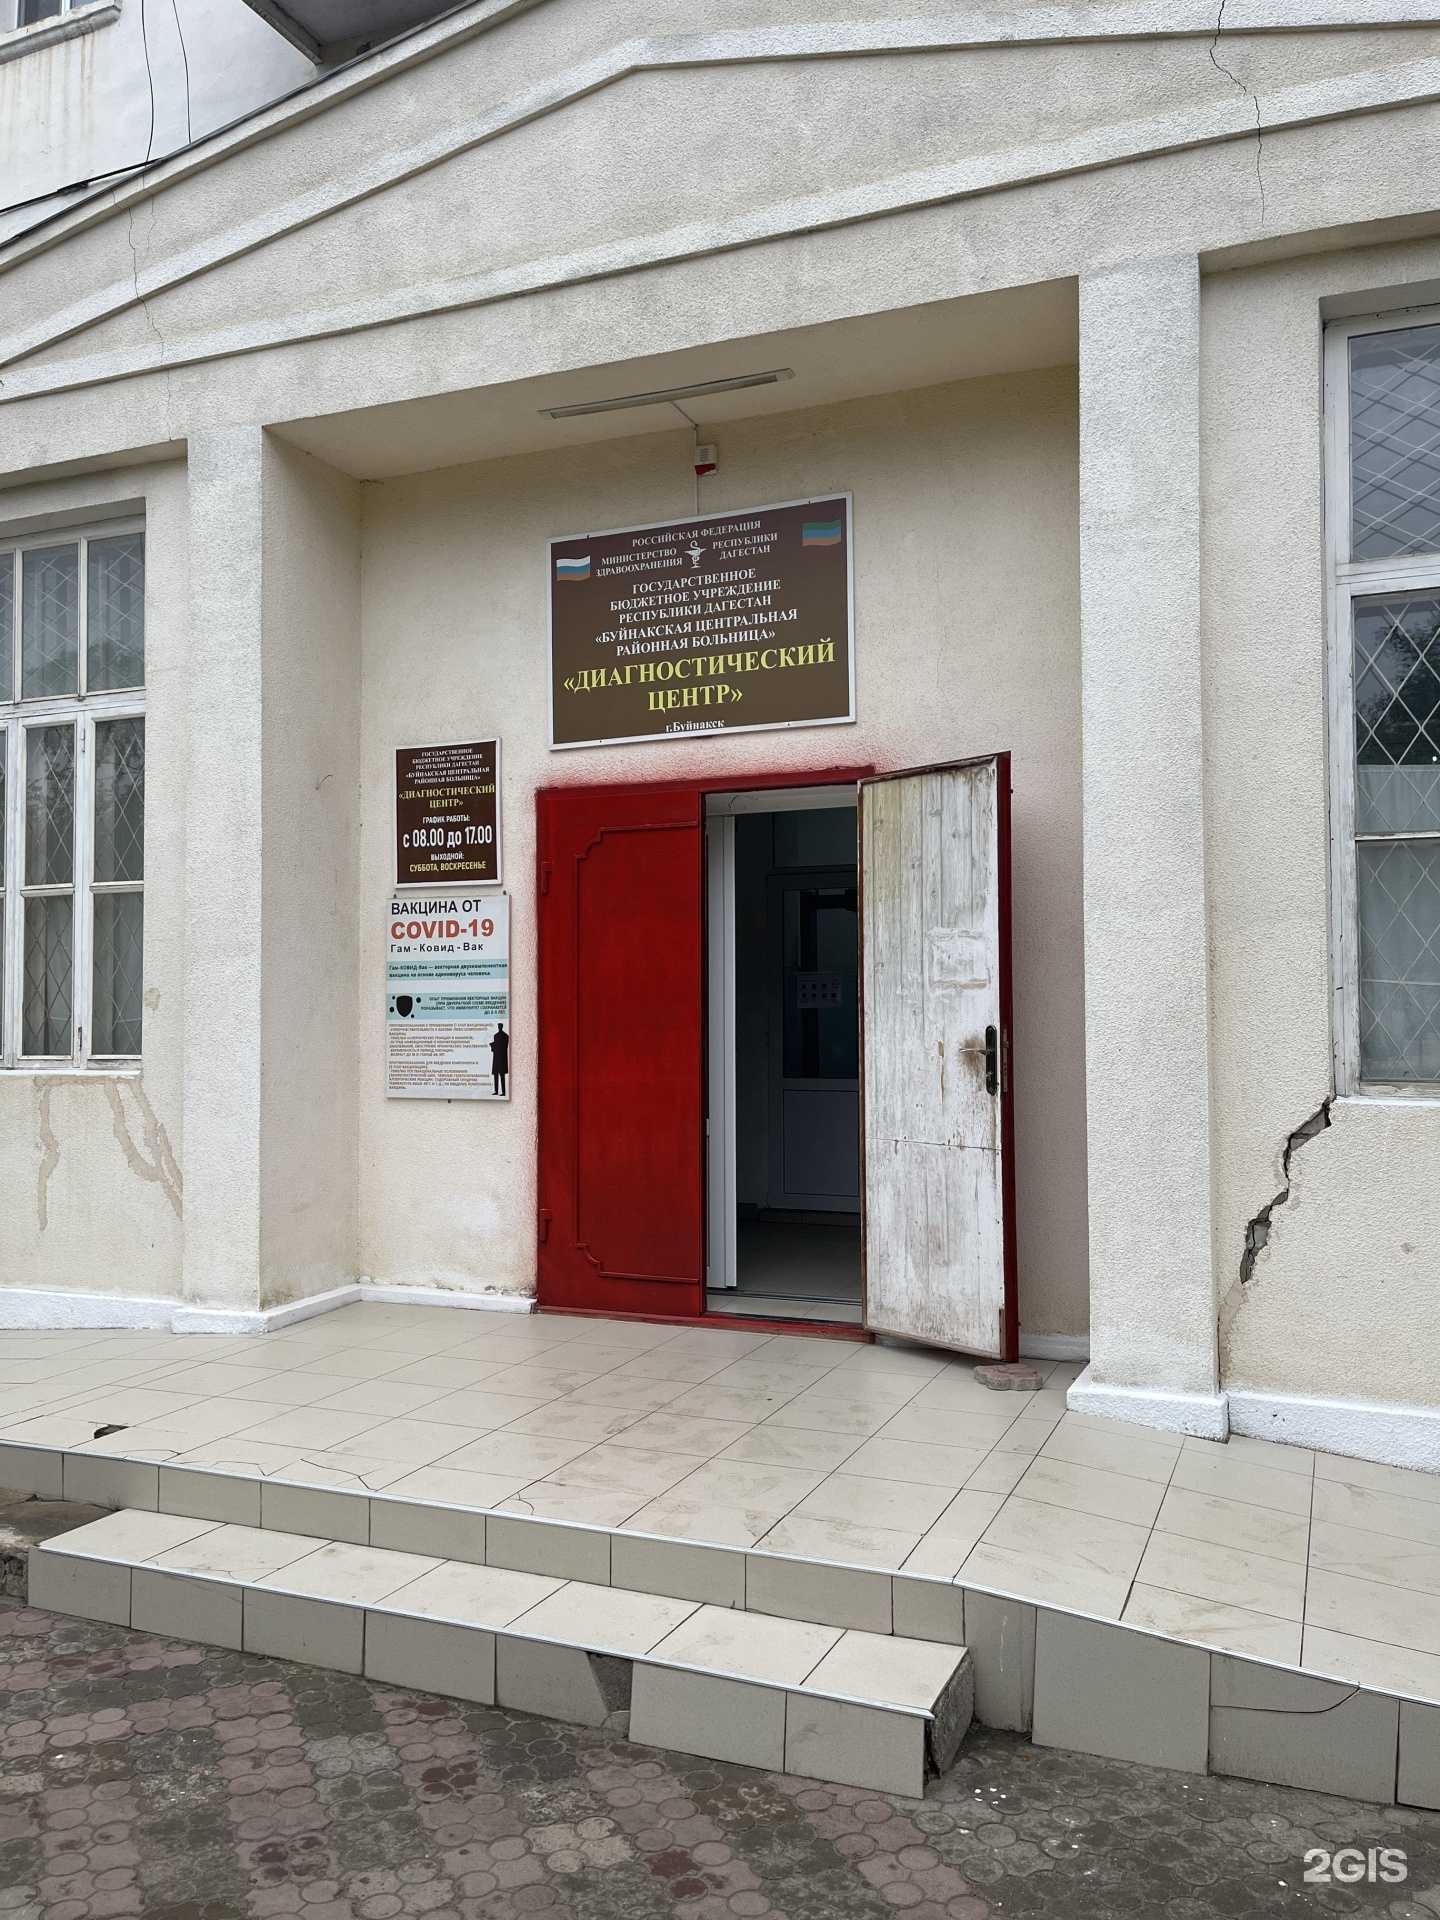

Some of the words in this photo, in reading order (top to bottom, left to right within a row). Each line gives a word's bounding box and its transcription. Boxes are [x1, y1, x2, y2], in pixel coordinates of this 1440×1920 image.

[632, 530, 699, 547] РОССИЙСКАЯ
[701, 520, 761, 537] ФЕДЕРАЦИЯ
[712, 532, 778, 550] РЕСПУБЛИКИ
[601, 548, 677, 566] МИНИСТЕРСТВО
[719, 544, 771, 560] ДАГЕСТАН
[595, 557, 683, 577] ЗДРАВООХРАНЕНИЯ
[632, 568, 756, 594] ГОСУДАРСТВЕННОЕ
[610, 591, 690, 612] БЮДЖЕТНОЕ
[692, 579, 781, 602] УЧРЕЖДЕНИЕ
[619, 604, 701, 624] РЕСПУБЛИКИ
[704, 595, 771, 615] ДАГЕСТАН
[595, 621, 692, 643] «БУЙНАКСКАЯ
[695, 609, 798, 633] ЦЕНТРАЛЬНАЯ
[616, 637, 688, 656] РАЙОННАЯ
[692, 629, 776, 649] БОЛЬНИЦА»
[563, 637, 836, 693] «ДИАГНОСТИЧЕСКИЙ
[648, 684, 743, 713] ЦЕНТР»
[665, 718, 725, 733] г.Буйнакск
[399, 783, 495, 799] «ДИАГНОСТИЧЕСКИЙ
[429, 799, 463, 808] ЦЕНТР»
[422, 816, 445, 824] ГРАФИК
[446, 814, 470, 822] РАБОТЫ:
[412, 828, 444, 847] 08.00
[447, 831, 462, 848] до
[464, 825, 492, 844] 17.00
[431, 851, 464, 861] ВЫХОДНОЙ:
[409, 863, 439, 872] СУББОТА,
[441, 861, 486, 871] ВОСКРЕСЕНЬЕ
[391, 901, 458, 916] ВАКЦИНА
[462, 899, 482, 913] ОТ
[391, 918, 494, 939] COVID-19
